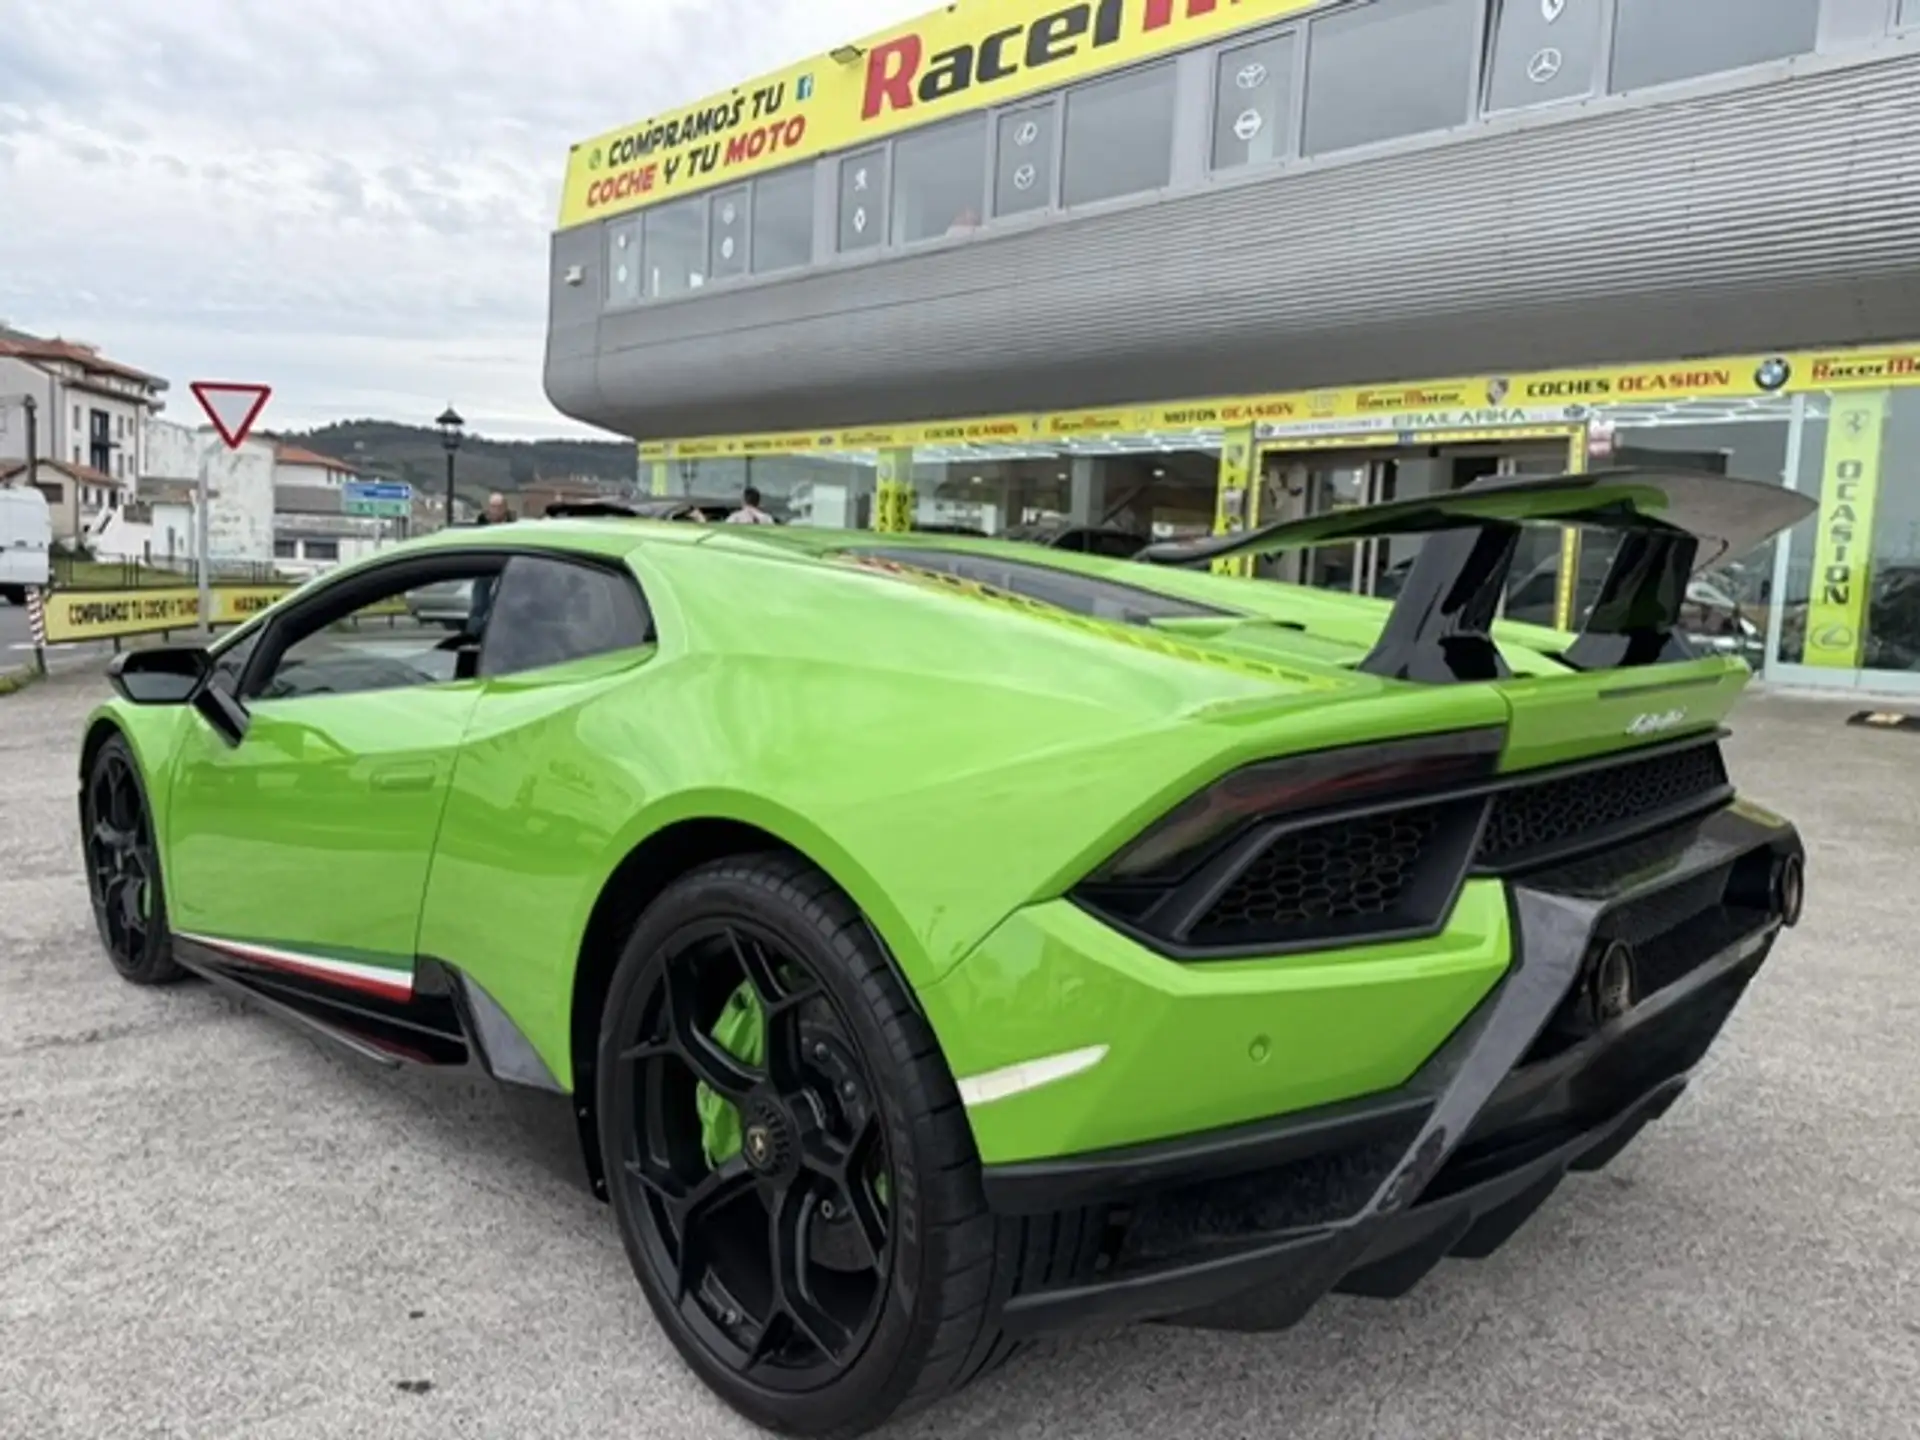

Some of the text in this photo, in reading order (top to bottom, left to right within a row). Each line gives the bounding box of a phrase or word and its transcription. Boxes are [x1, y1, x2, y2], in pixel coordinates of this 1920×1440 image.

[586, 114, 806, 208] COCHE Y TU MOTO
[608, 82, 785, 168] COMPRAMOS TU
[1164, 401, 1294, 423] MOTOS OCASION
[1526, 370, 1731, 398] COCHES OCASION
[1824, 459, 1863, 605] OCASION
